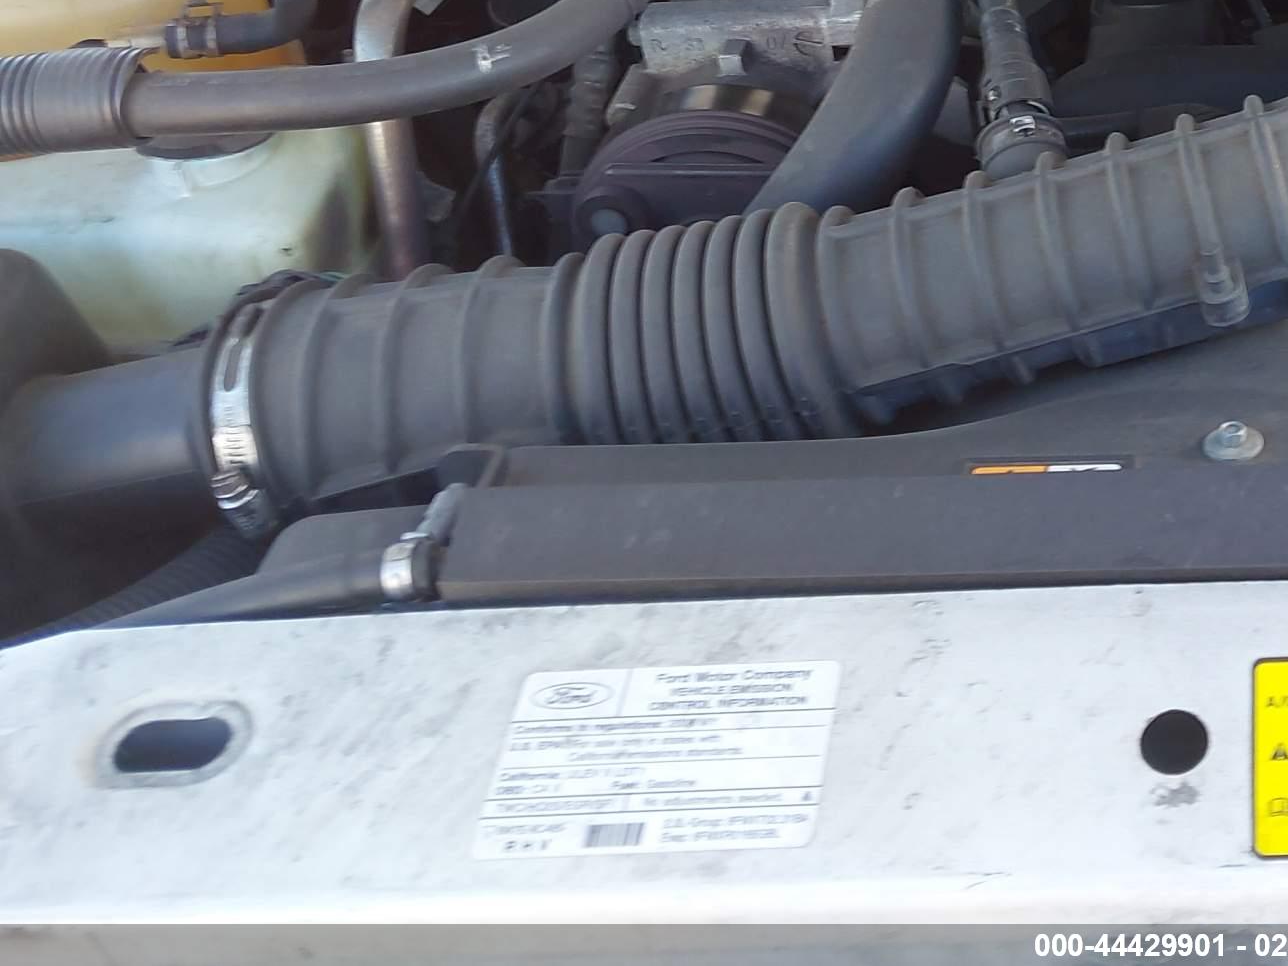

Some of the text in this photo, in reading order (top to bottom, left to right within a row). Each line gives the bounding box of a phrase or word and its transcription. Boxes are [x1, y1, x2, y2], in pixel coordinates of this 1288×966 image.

[656, 668, 813, 684] Ford Motor Company
[546, 686, 596, 705] Ford
